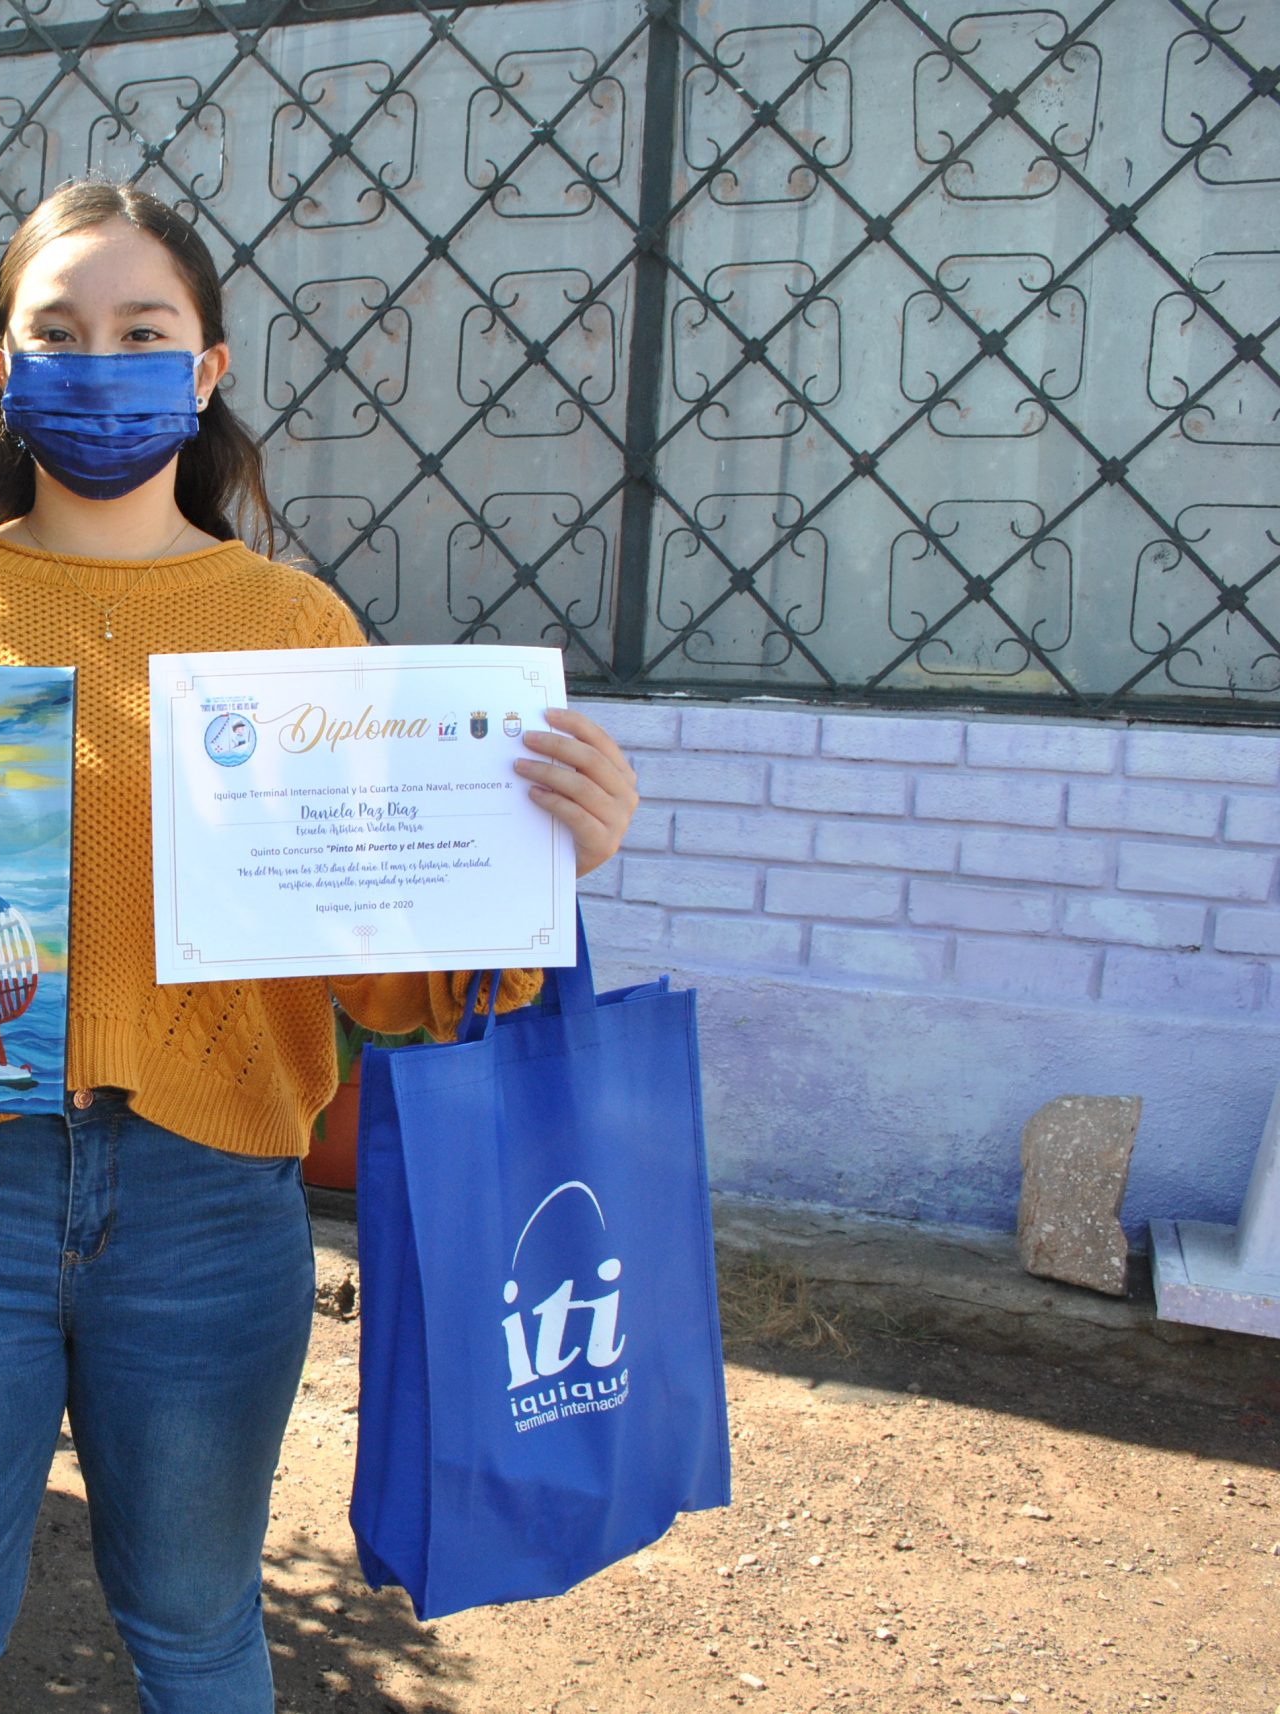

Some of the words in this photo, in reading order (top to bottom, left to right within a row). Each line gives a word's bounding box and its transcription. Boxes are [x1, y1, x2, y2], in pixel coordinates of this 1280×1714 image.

[253, 702, 432, 754] Diploma
[214, 792, 248, 801] Iquique
[250, 788, 288, 798] Terminal
[290, 785, 350, 797] Internacional
[351, 787, 357, 796] y
[359, 785, 367, 794] la
[370, 783, 399, 793] Cuarta
[401, 783, 424, 792] Zona
[426, 782, 454, 792] Naval,
[456, 780, 502, 790] reconocen
[504, 781, 513, 789] a:
[301, 802, 355, 820] Daniela
[358, 801, 384, 821] Paz
[387, 801, 419, 820] Díaz
[296, 825, 327, 836] Escuela
[366, 821, 396, 833] Violeta
[398, 821, 424, 833] Parra
[250, 847, 280, 857] Quinto
[282, 846, 324, 855] Concurso
[355, 843, 366, 852] Mi
[368, 842, 398, 851] Puerto
[399, 843, 405, 852] y
[407, 841, 415, 850] el
[417, 841, 434, 850] Mes
[437, 840, 451, 849] del
[254, 865, 266, 876] del
[314, 862, 329, 873] 365
[347, 861, 360, 872] del
[316, 903, 352, 914] Iquique,
[353, 901, 377, 912] junio
[379, 900, 391, 909] de
[392, 900, 414, 909] 2020
[501, 1258, 626, 1391] iti
[515, 1404, 559, 1433] terminal
